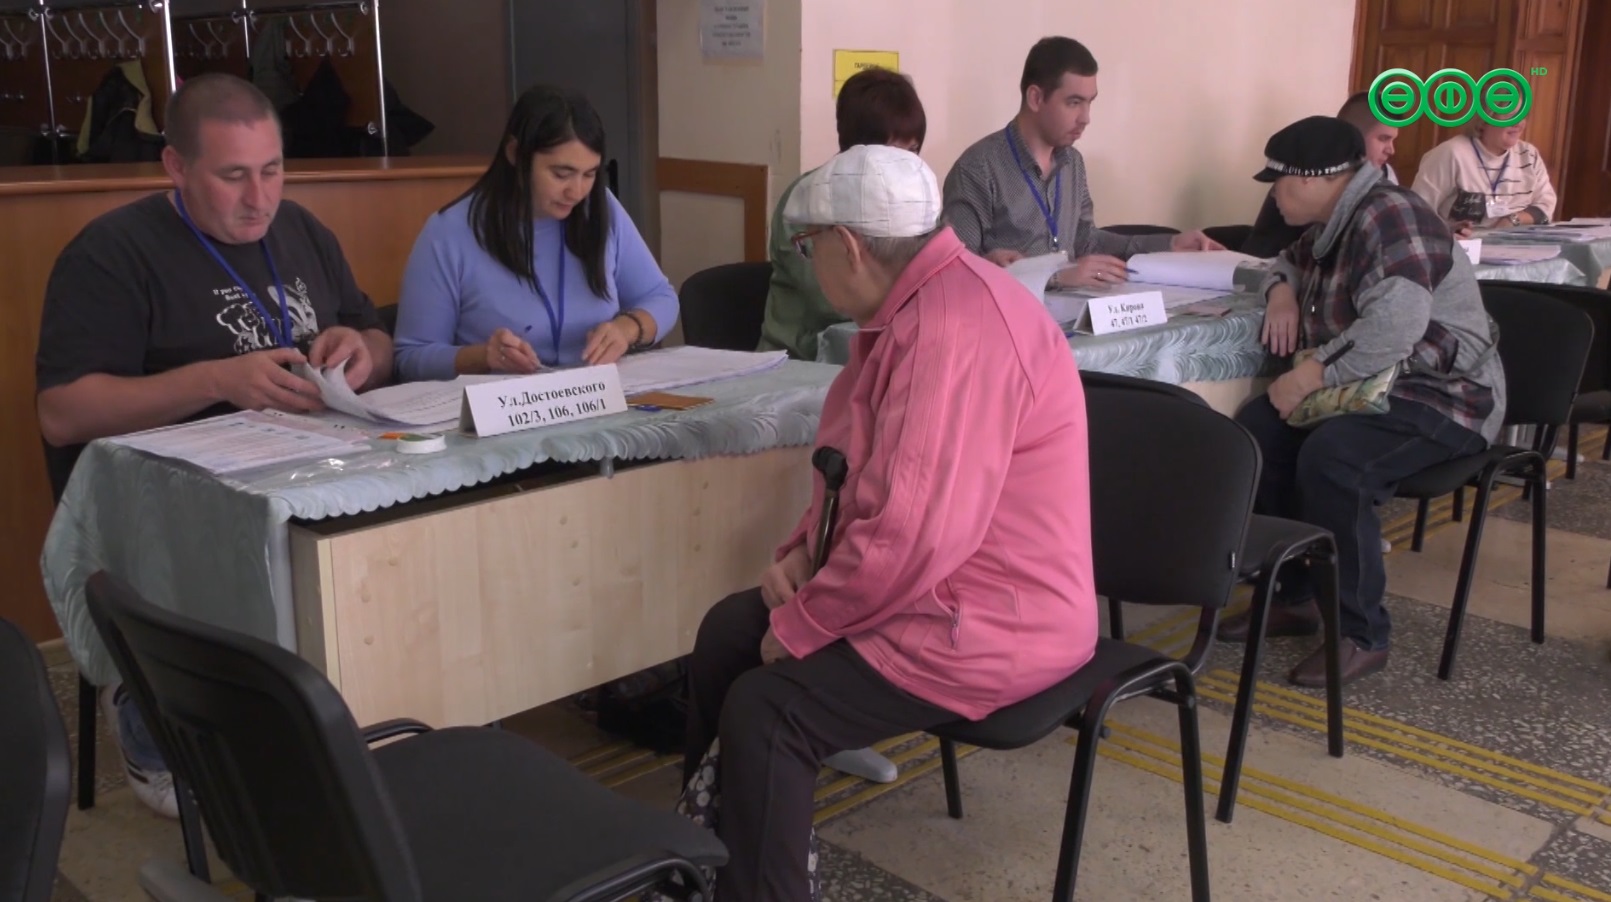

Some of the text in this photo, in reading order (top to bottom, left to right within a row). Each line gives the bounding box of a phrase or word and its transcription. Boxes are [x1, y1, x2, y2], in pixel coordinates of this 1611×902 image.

[1120, 303, 1144, 313] Кирова
[508, 398, 606, 427] 102/3, 106, 106/1
